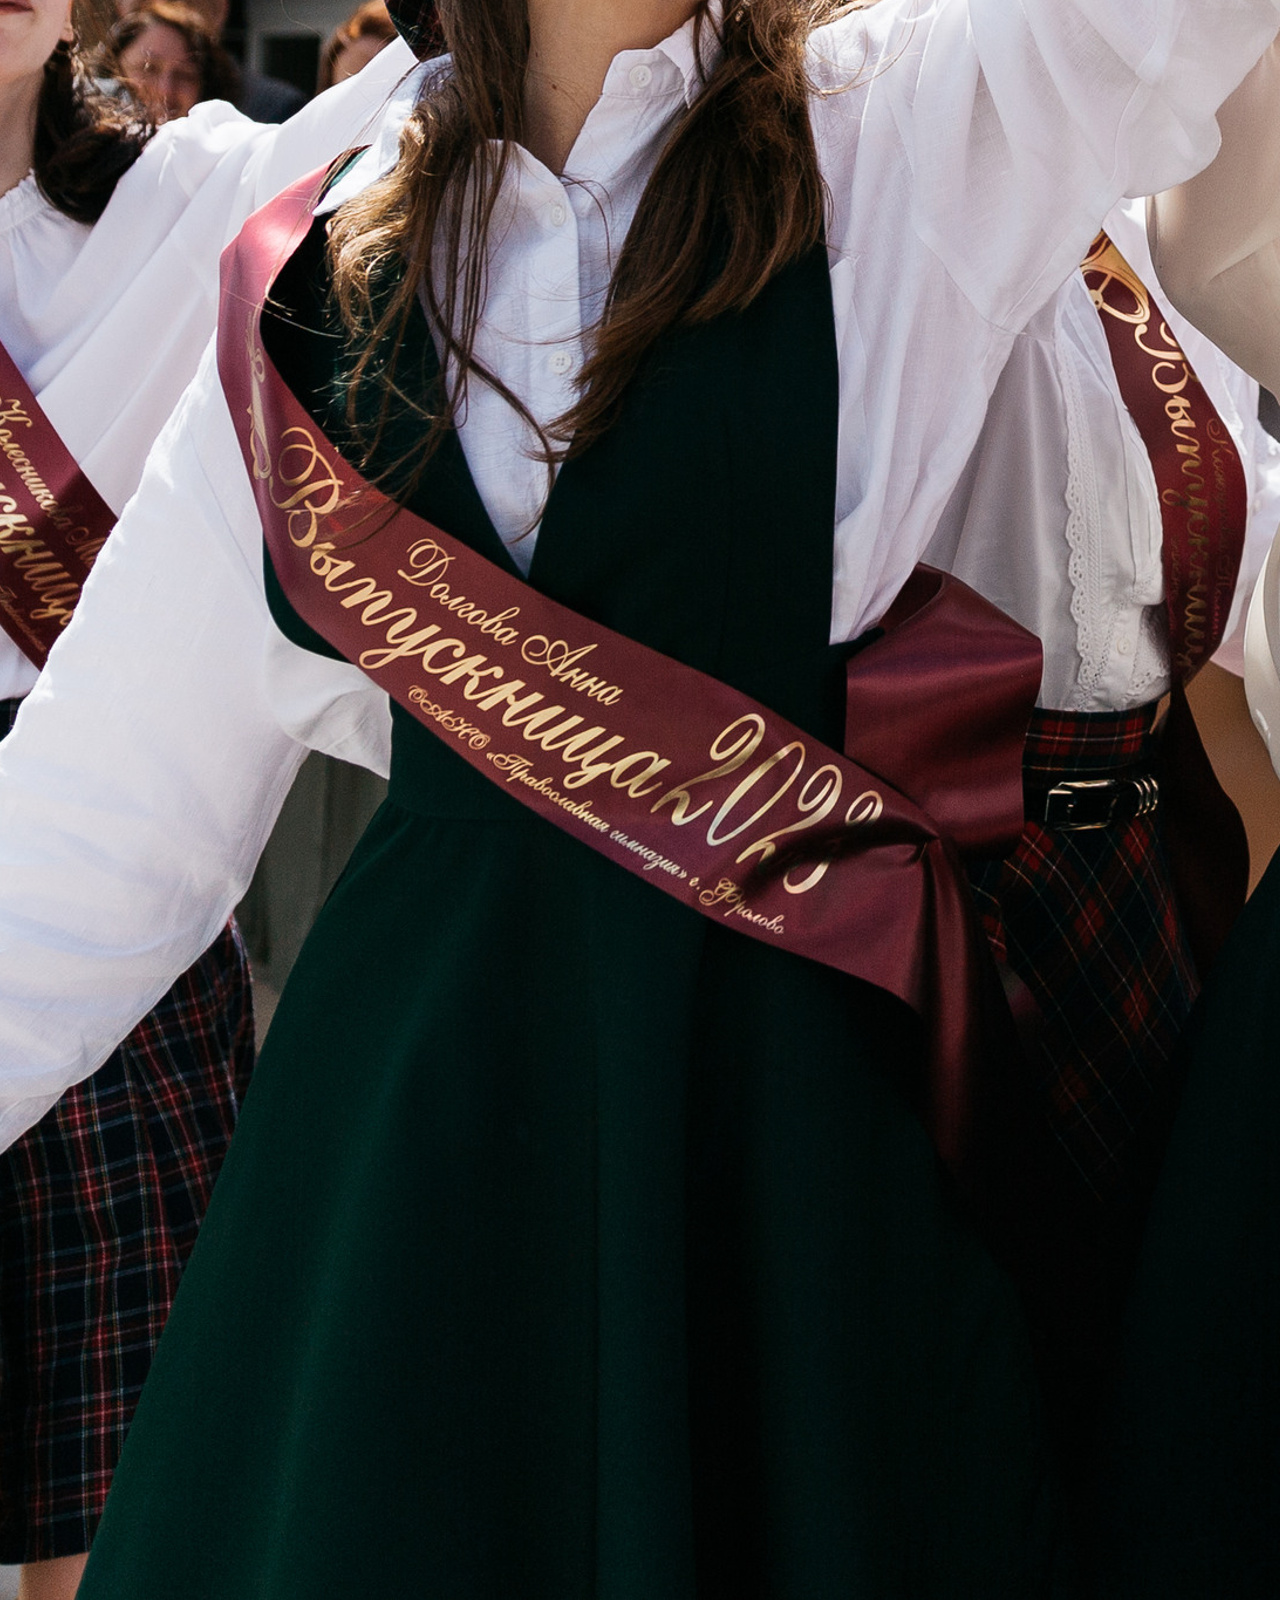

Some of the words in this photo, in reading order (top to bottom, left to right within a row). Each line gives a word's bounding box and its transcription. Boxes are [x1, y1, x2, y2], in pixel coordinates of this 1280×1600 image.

[269, 426, 672, 801] Выпускница
[398, 539, 520, 646] Долгова
[521, 633, 624, 706] Анна
[699, 877, 785, 935] Фролово
